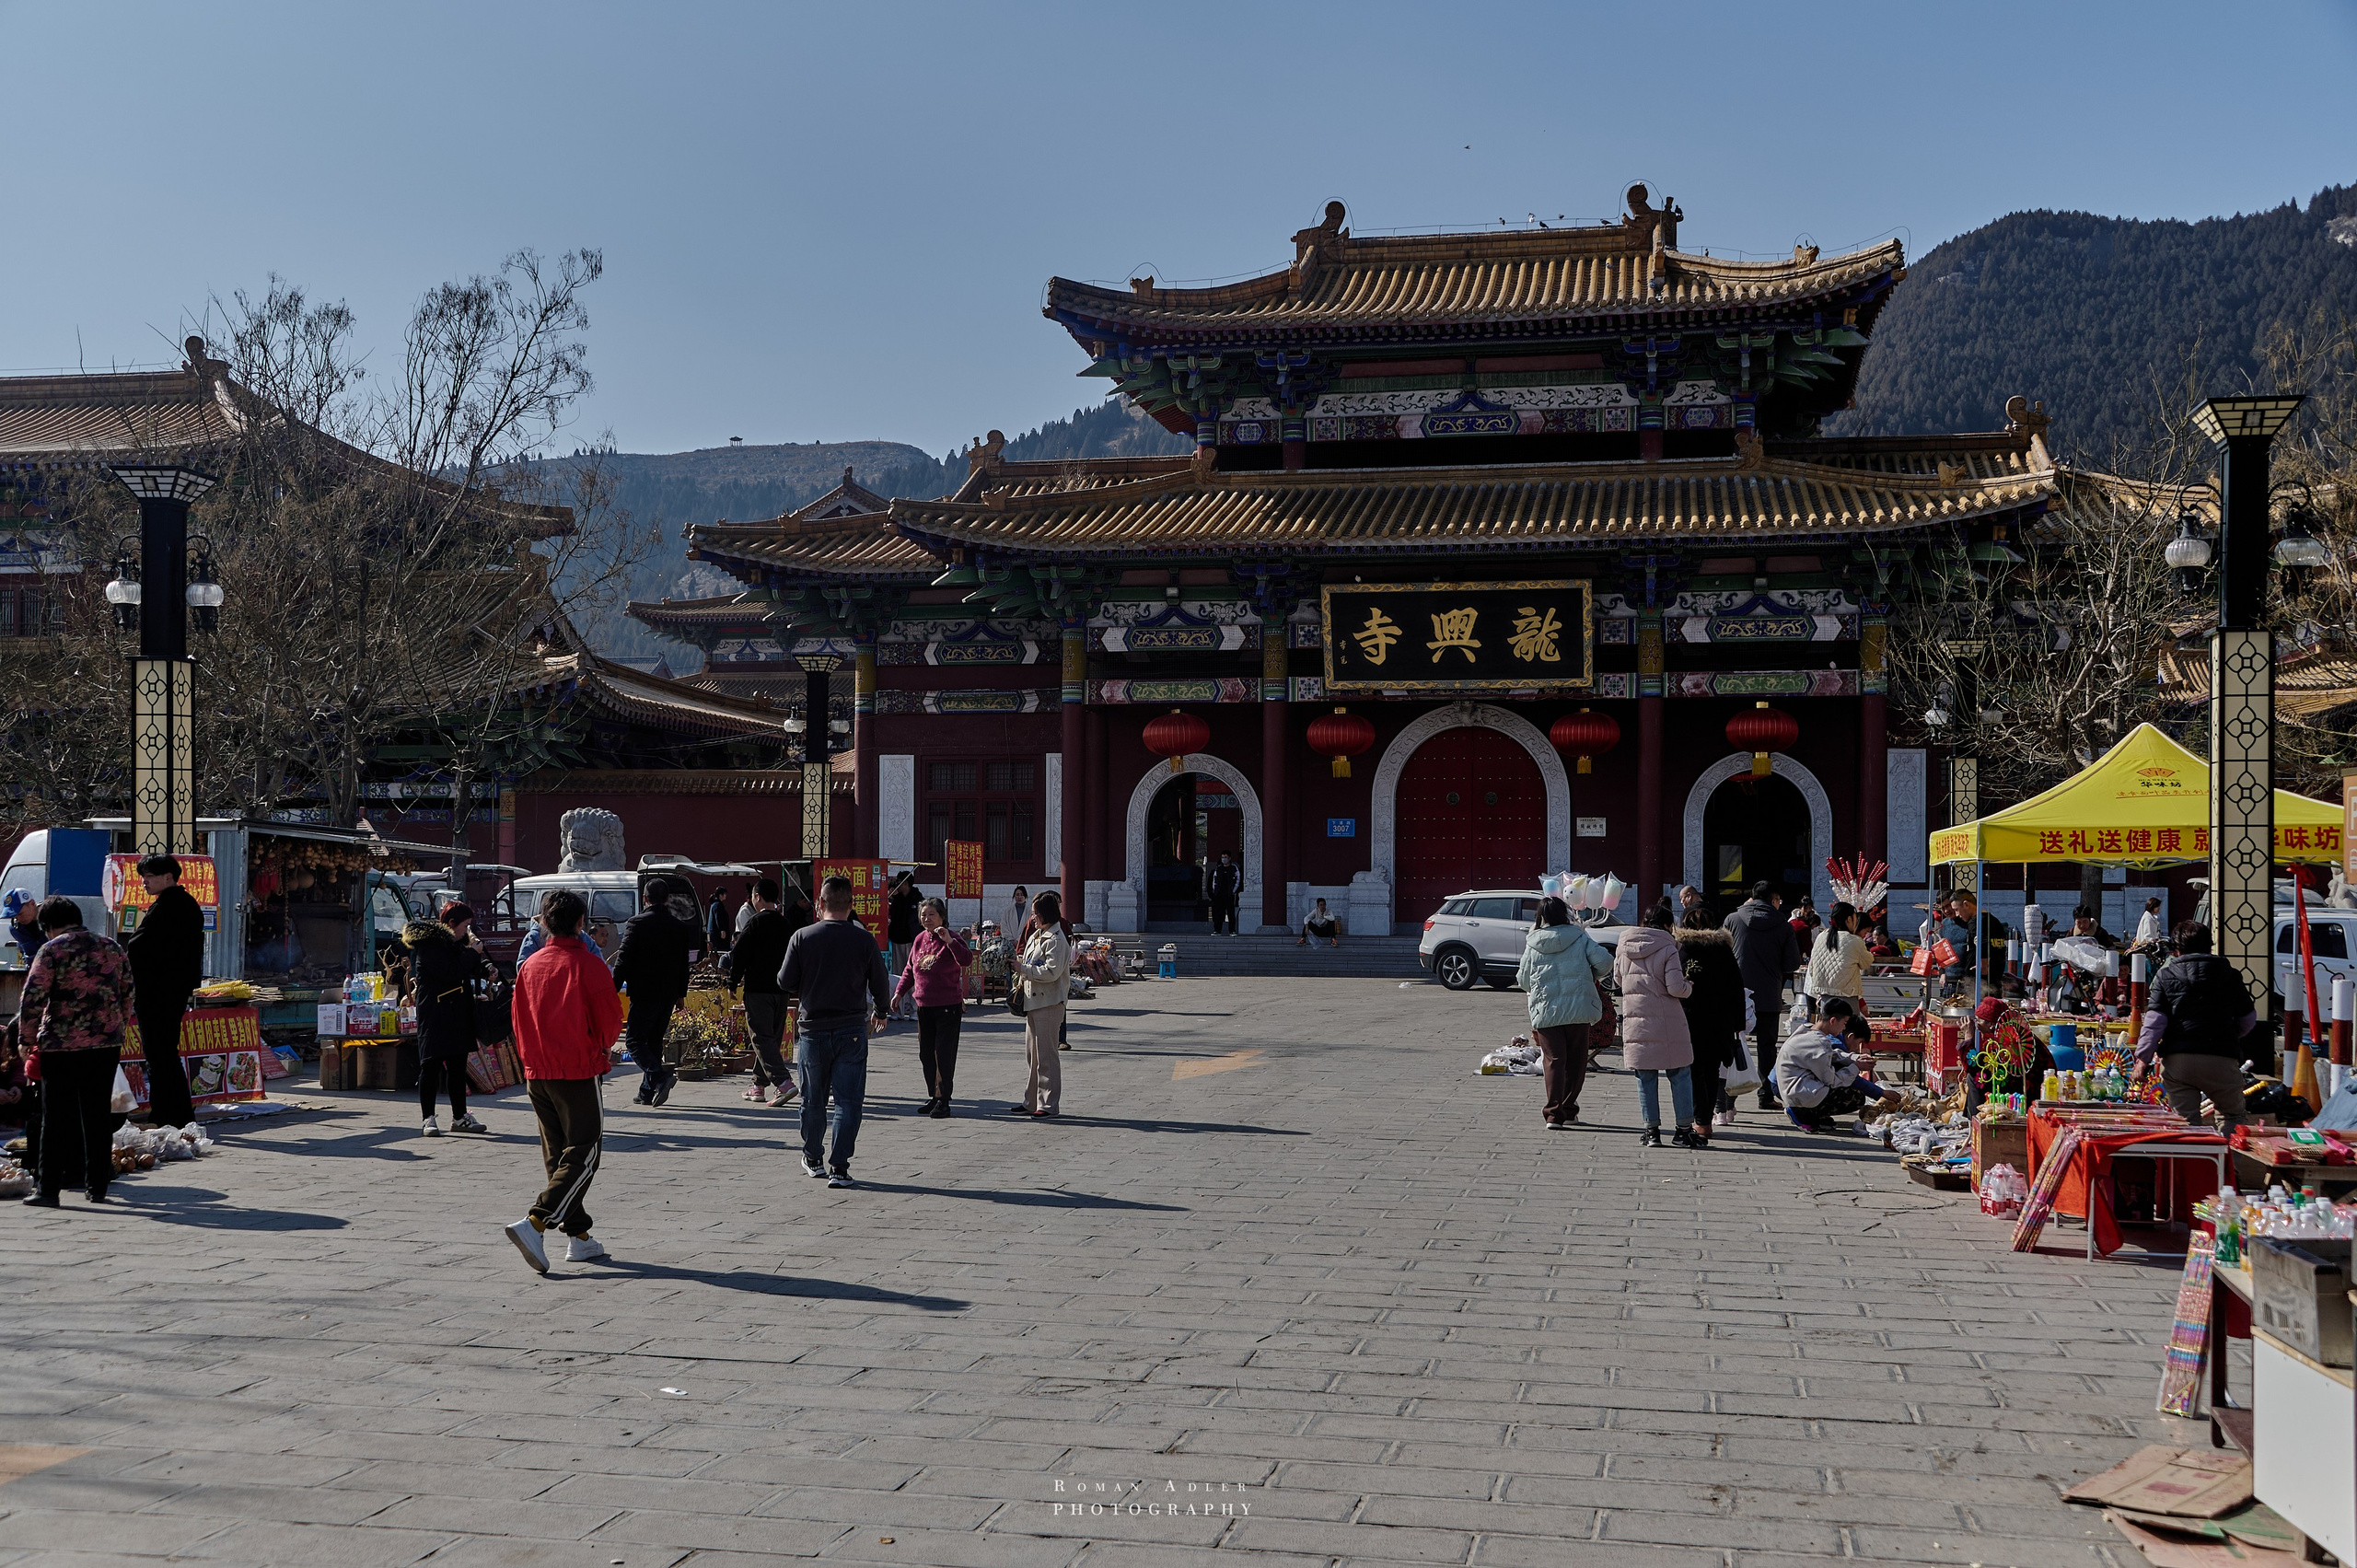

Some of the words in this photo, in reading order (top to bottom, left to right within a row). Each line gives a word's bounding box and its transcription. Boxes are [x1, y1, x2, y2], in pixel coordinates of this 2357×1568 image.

[1353, 606, 1562, 665] 龍興寺
[2039, 828, 2183, 854] 送礼送健康
